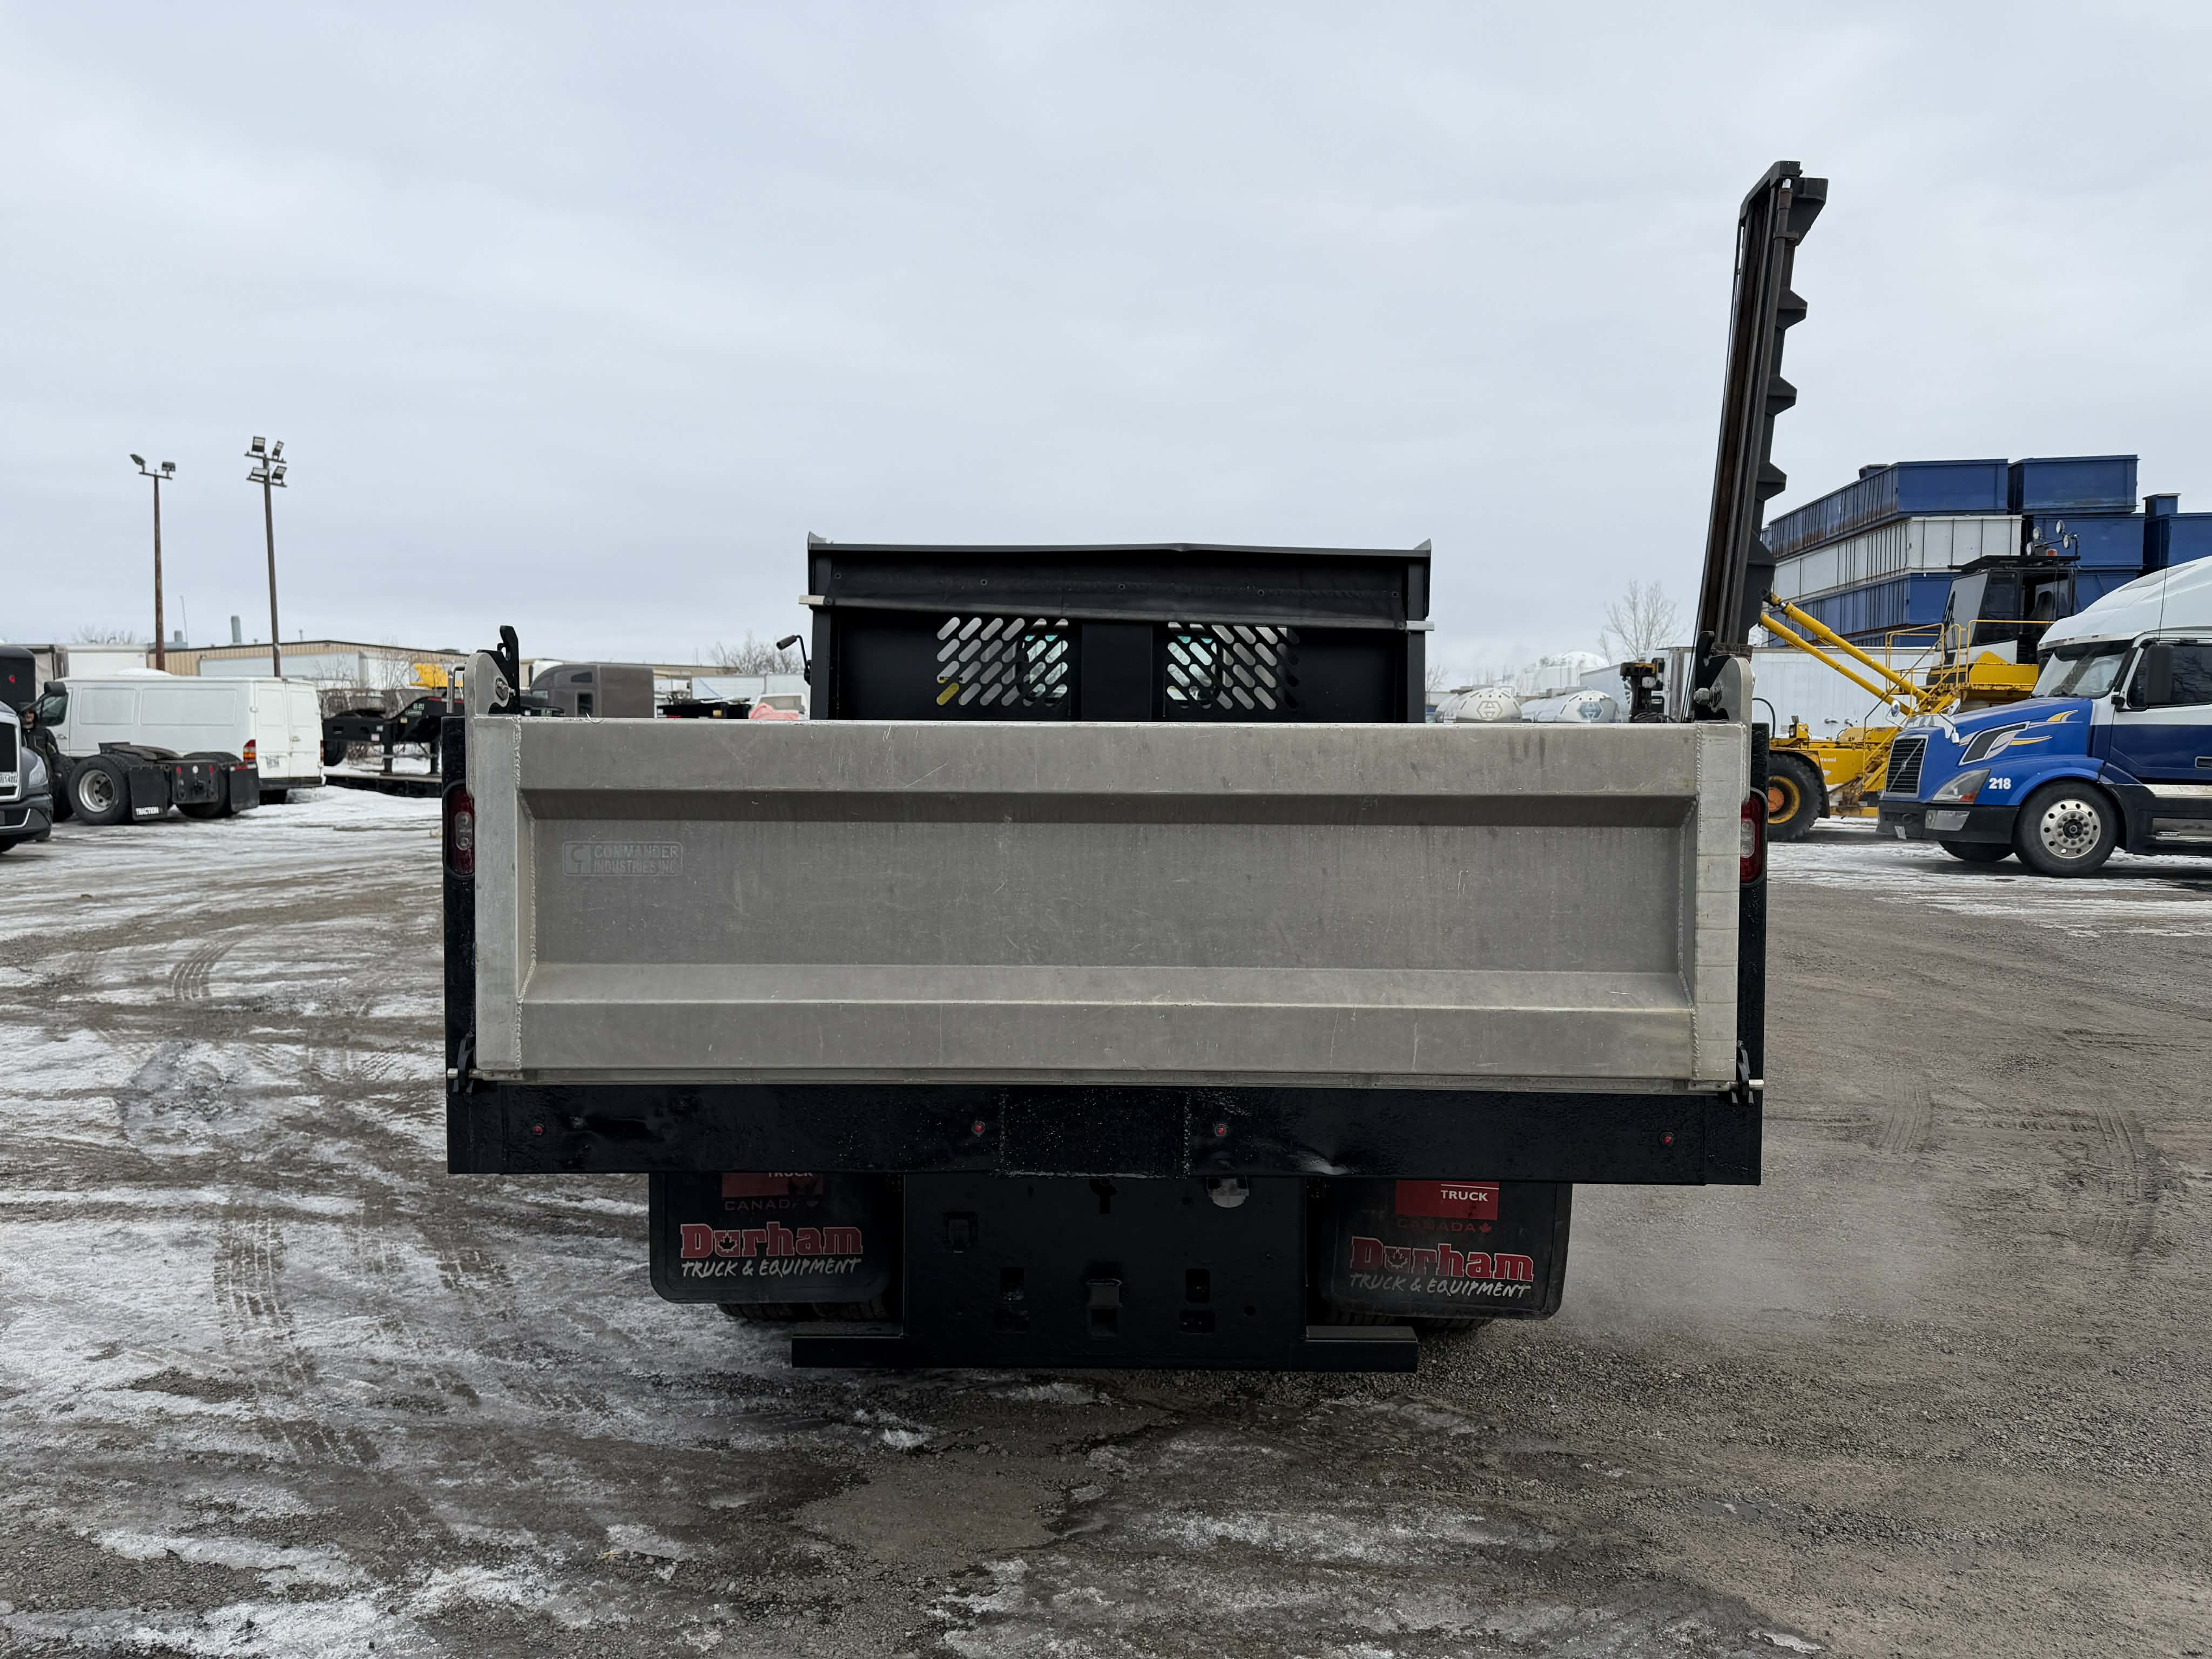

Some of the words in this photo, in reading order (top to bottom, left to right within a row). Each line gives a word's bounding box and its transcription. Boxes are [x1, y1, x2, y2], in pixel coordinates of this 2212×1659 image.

[1988, 778, 2011, 790] 218
[594, 845, 679, 858] COMMANDER
[595, 859, 656, 873] INDUSTRIES
[1440, 1190, 1488, 1202] TRUCK
[1398, 1219, 1476, 1232] CANADA
[680, 1222, 864, 1258] Durham
[1350, 1236, 1534, 1282] Durham
[681, 1260, 738, 1278] TRUCK
[742, 1260, 754, 1276] &
[759, 1257, 862, 1279] EQUIPMENT
[1350, 1272, 1405, 1292] TRUCK
[1410, 1278, 1422, 1293] &
[1427, 1279, 1532, 1299] EQUIPMENT
